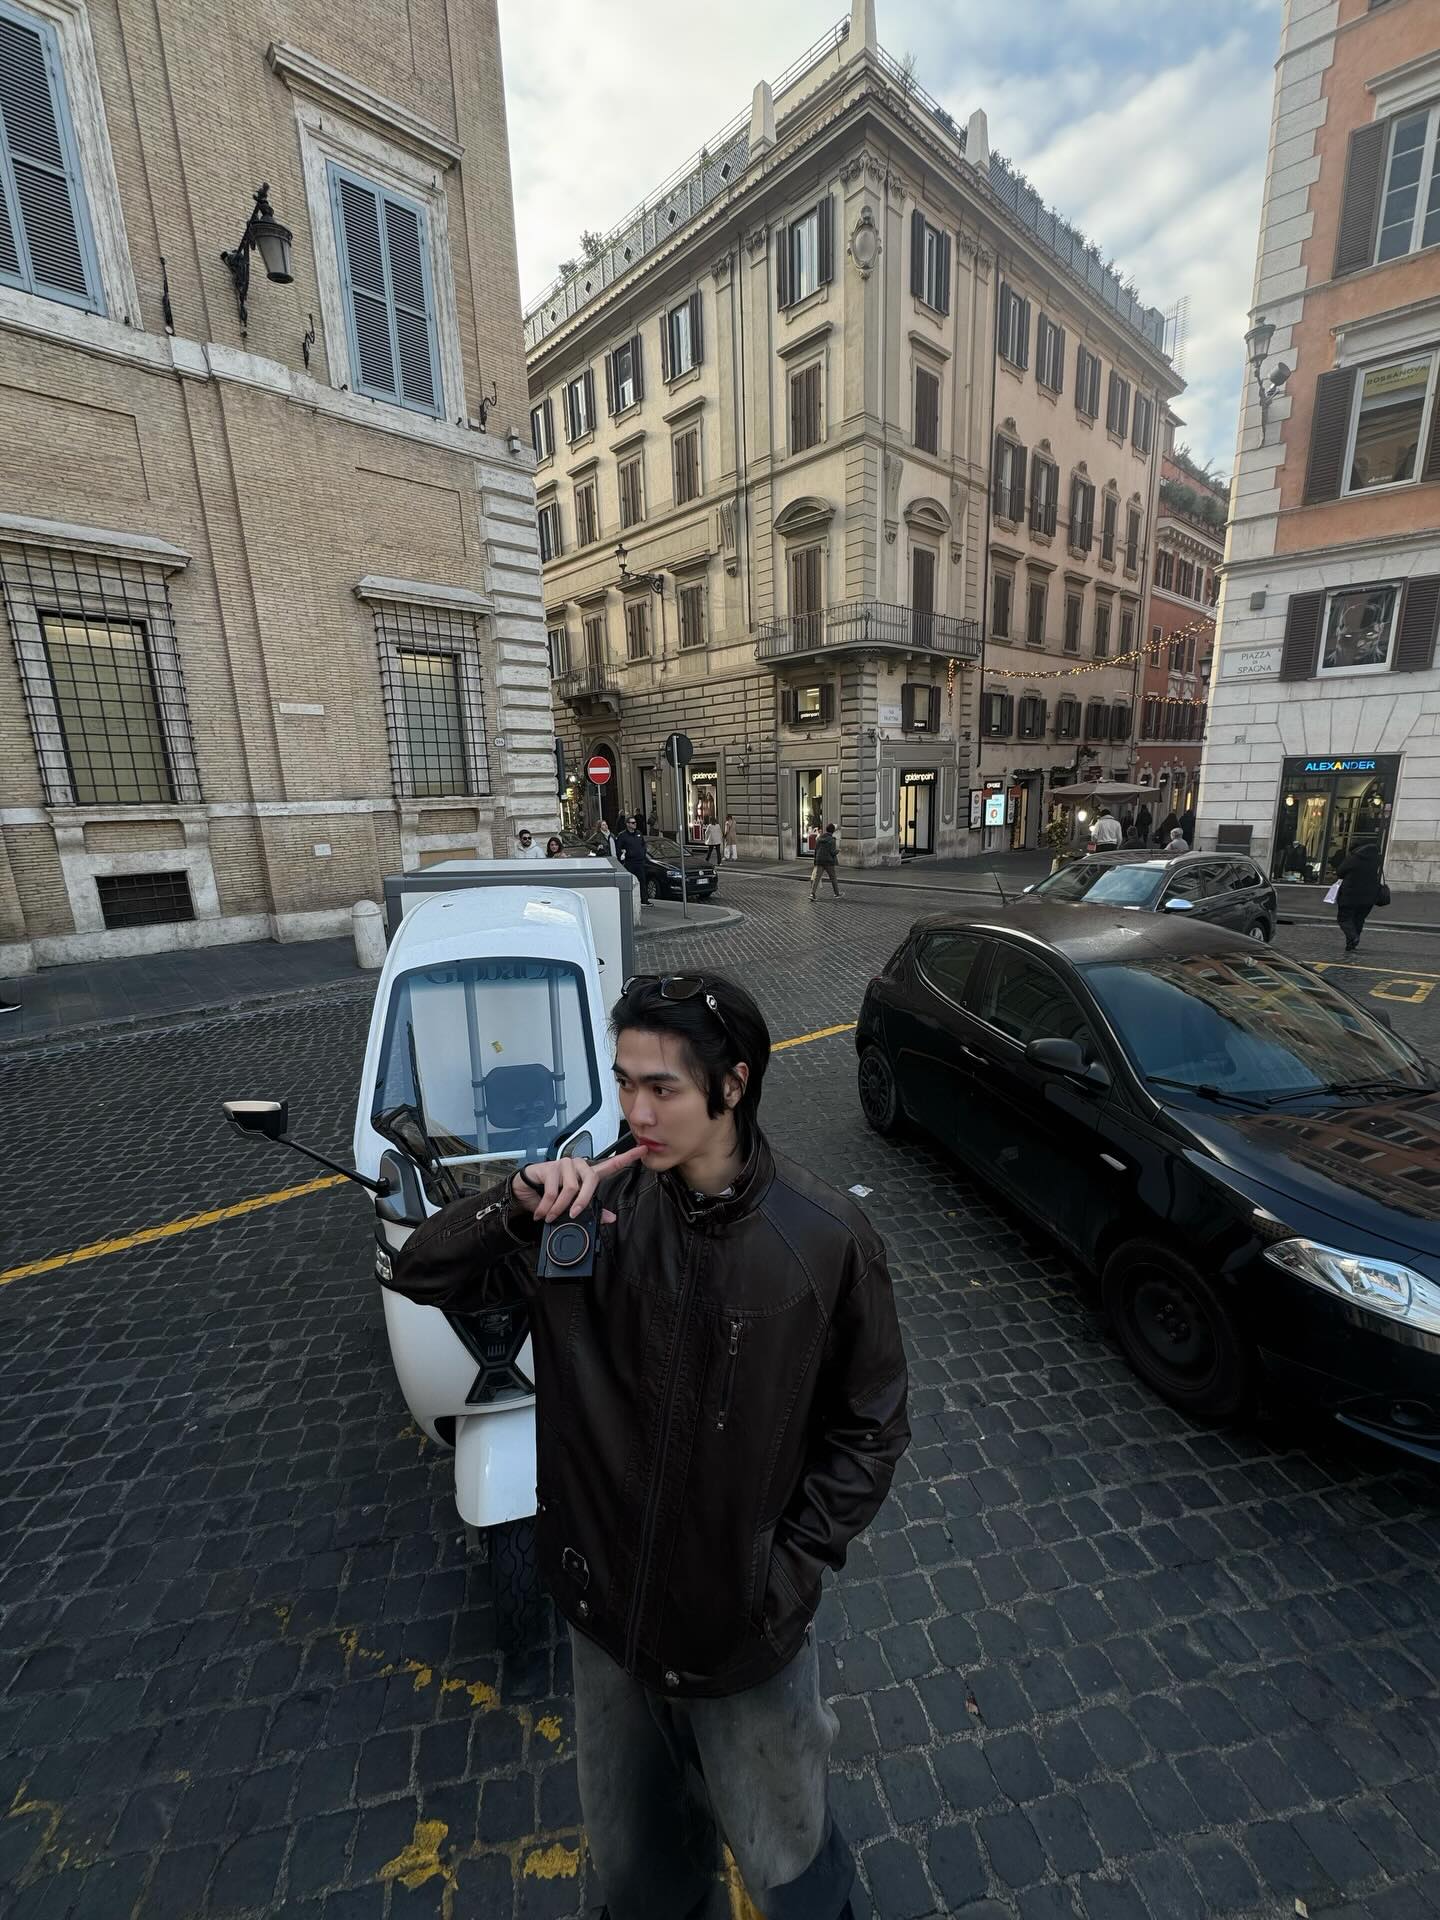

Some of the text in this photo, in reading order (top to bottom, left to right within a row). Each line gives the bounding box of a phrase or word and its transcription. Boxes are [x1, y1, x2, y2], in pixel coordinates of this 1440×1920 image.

[1241, 651, 1271, 660] PIAZZA
[1237, 665, 1272, 674] SPAGNA
[1304, 761, 1375, 771] ALEXANDER
[904, 772, 934, 784] goldenpoint
